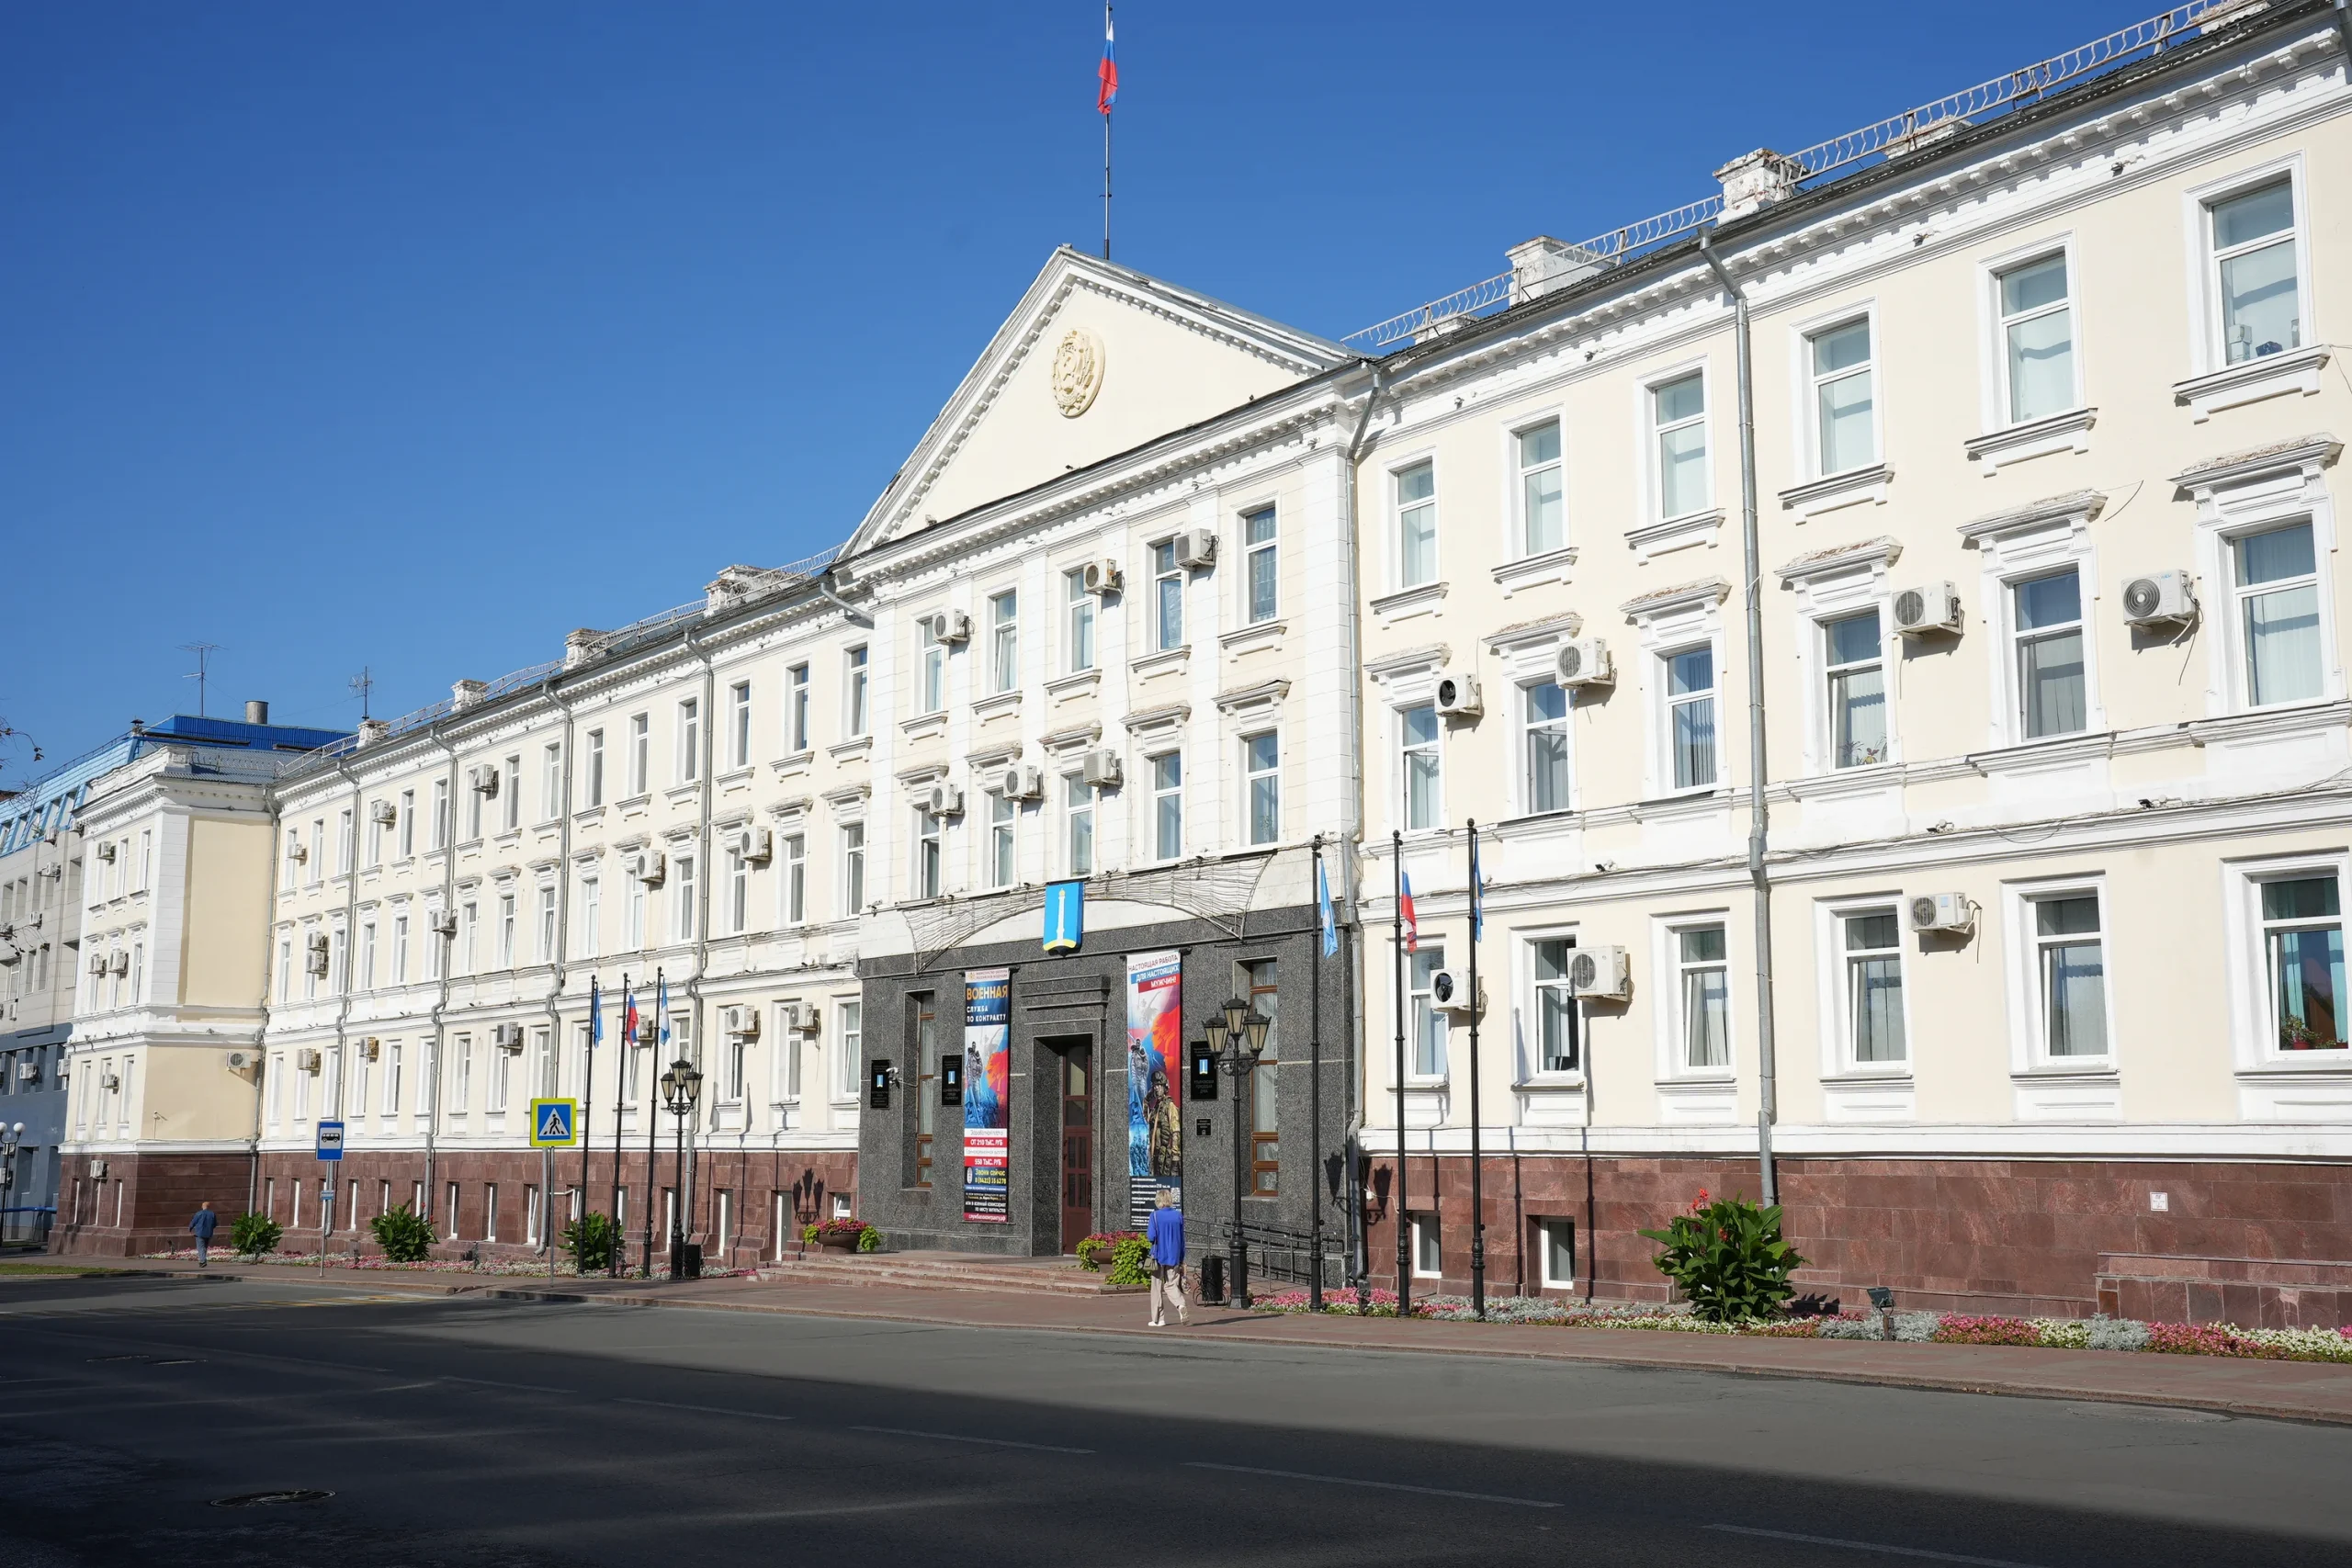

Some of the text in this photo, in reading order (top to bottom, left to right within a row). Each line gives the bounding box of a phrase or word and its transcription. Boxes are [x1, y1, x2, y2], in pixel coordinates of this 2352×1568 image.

[1128, 954, 1178, 971] НАСТОЯЩАЯ РАБОТА
[1136, 964, 1180, 982] ДЛЯ НАСТОЯЩИХ
[1151, 977, 1176, 988] МУЖЧИН!
[967, 985, 1008, 1000] ВОЕННАЯ
